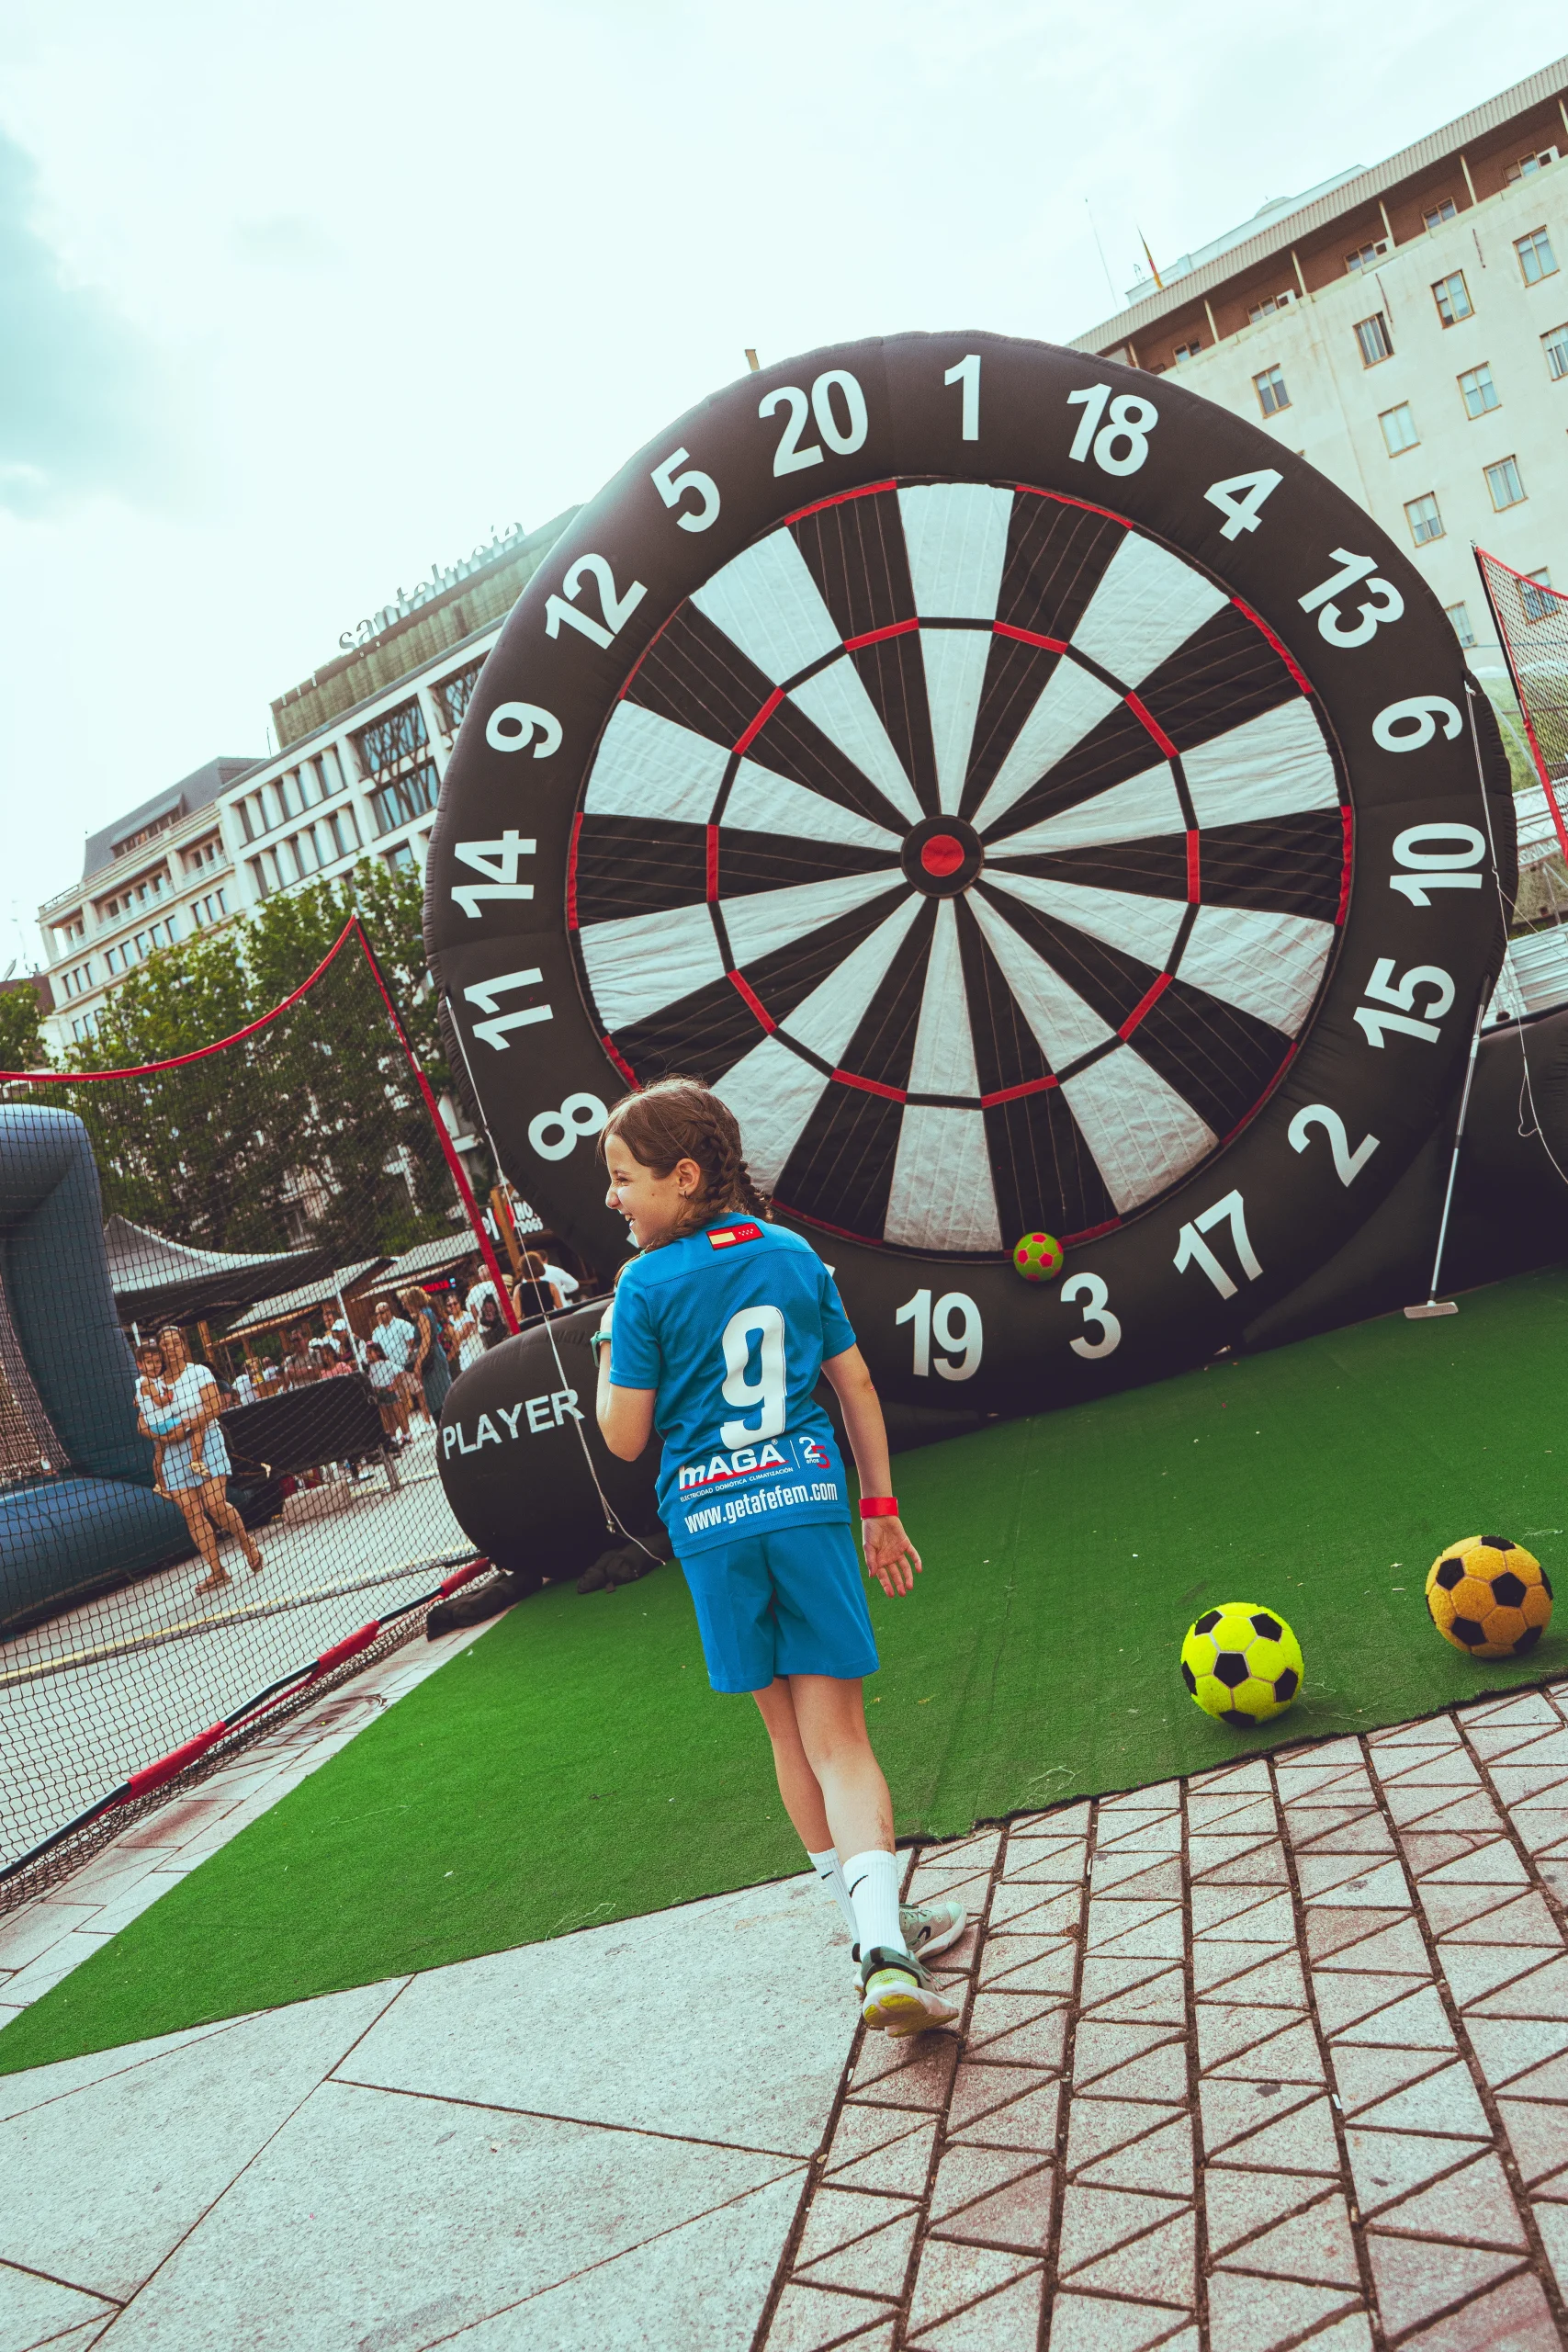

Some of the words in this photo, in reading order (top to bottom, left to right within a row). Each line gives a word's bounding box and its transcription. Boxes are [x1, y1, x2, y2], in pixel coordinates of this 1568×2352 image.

[758, 369, 869, 478] 20
[944, 355, 981, 441] 1
[1066, 382, 1159, 477] 18
[650, 447, 721, 533] 5
[1202, 468, 1284, 542] 4
[545, 553, 646, 650] 12
[1297, 547, 1404, 649] 13
[485, 701, 563, 759] 9
[1371, 695, 1463, 753] 6
[450, 829, 537, 919] 14
[1389, 822, 1486, 907] 10
[463, 967, 554, 1051] 11
[1352, 957, 1456, 1049] 15
[528, 1091, 608, 1161] 8
[1287, 1103, 1381, 1188] 2
[1172, 1189, 1263, 1300] 17
[895, 1288, 983, 1381] 19
[1060, 1272, 1122, 1359] 3
[720, 1305, 788, 1450] 9
[442, 1388, 584, 1461] PLAYER
[680, 1487, 714, 1503] ELECTRICIDAD
[749, 1466, 794, 1482] CLIMATIZACIÓN
[684, 1482, 838, 1533] www.getafefem.com
